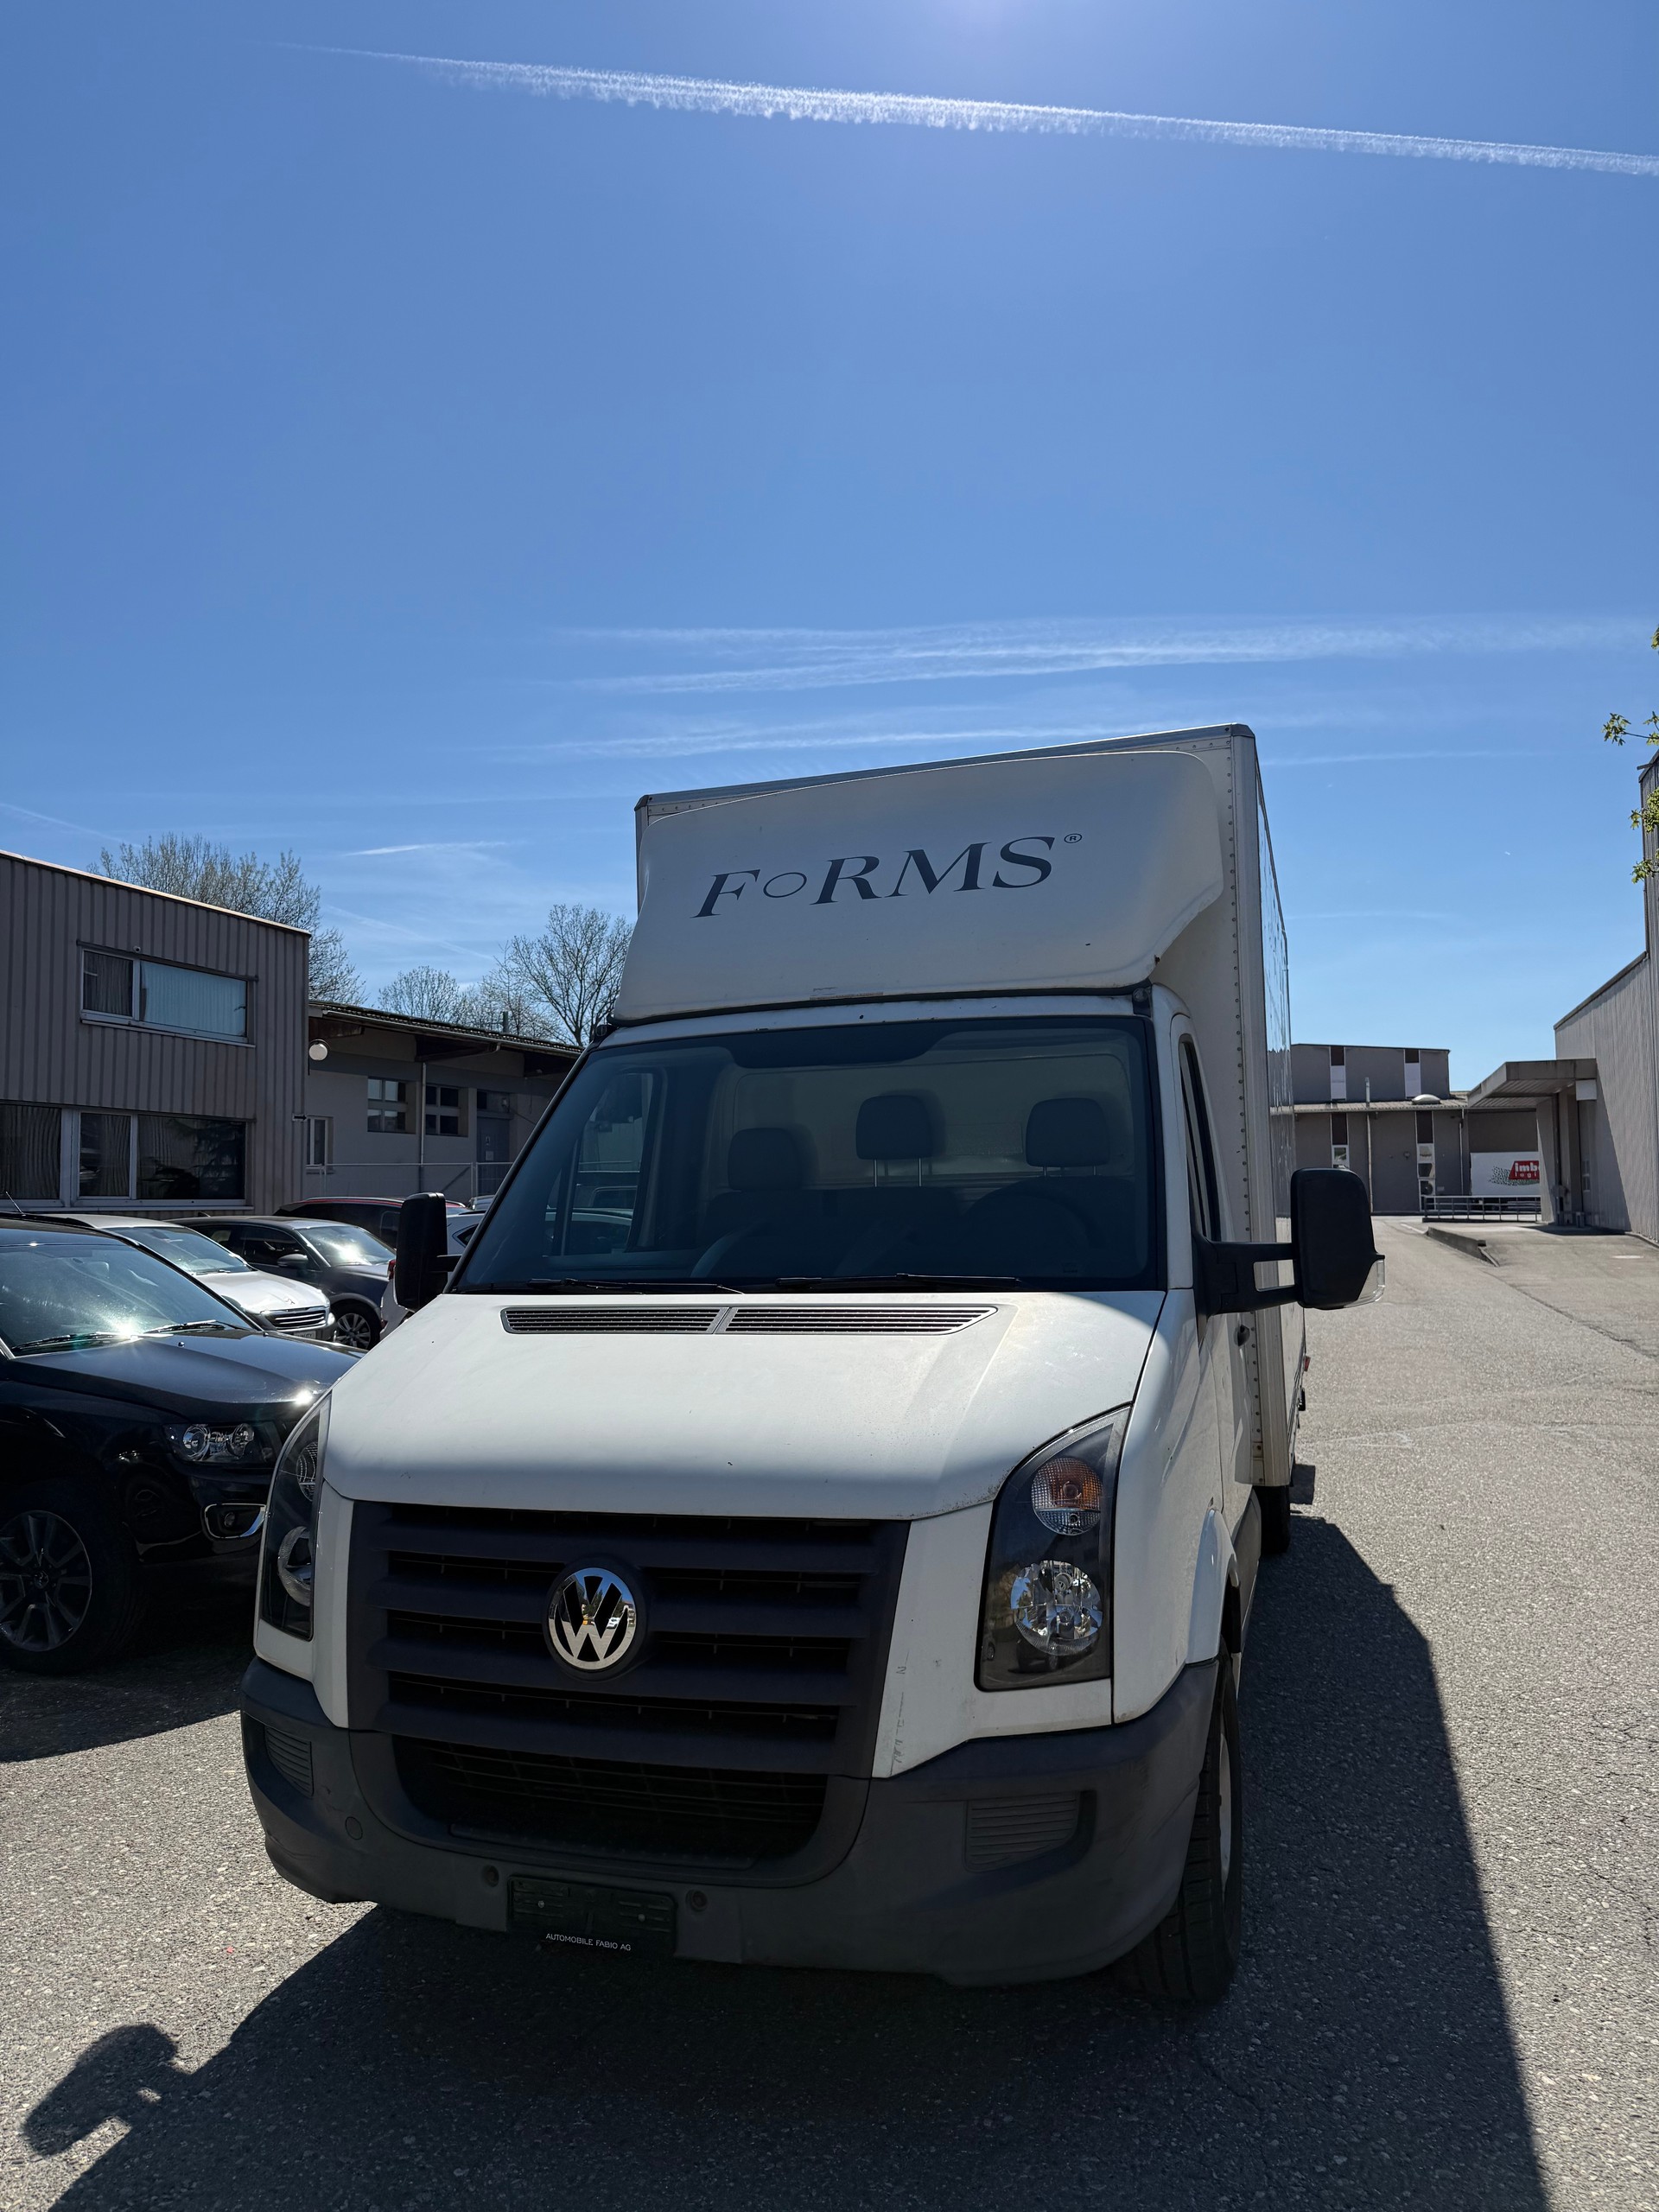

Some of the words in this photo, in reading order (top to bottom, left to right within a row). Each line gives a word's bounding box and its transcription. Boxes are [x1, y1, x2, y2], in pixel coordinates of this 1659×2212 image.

[1515, 1162, 1539, 1172] imb
[549, 1567, 636, 1669] VW
[545, 1933, 594, 1946] AUTOMOBILE
[595, 1940, 619, 1949] FABIO
[620, 1943, 632, 1952] AG
